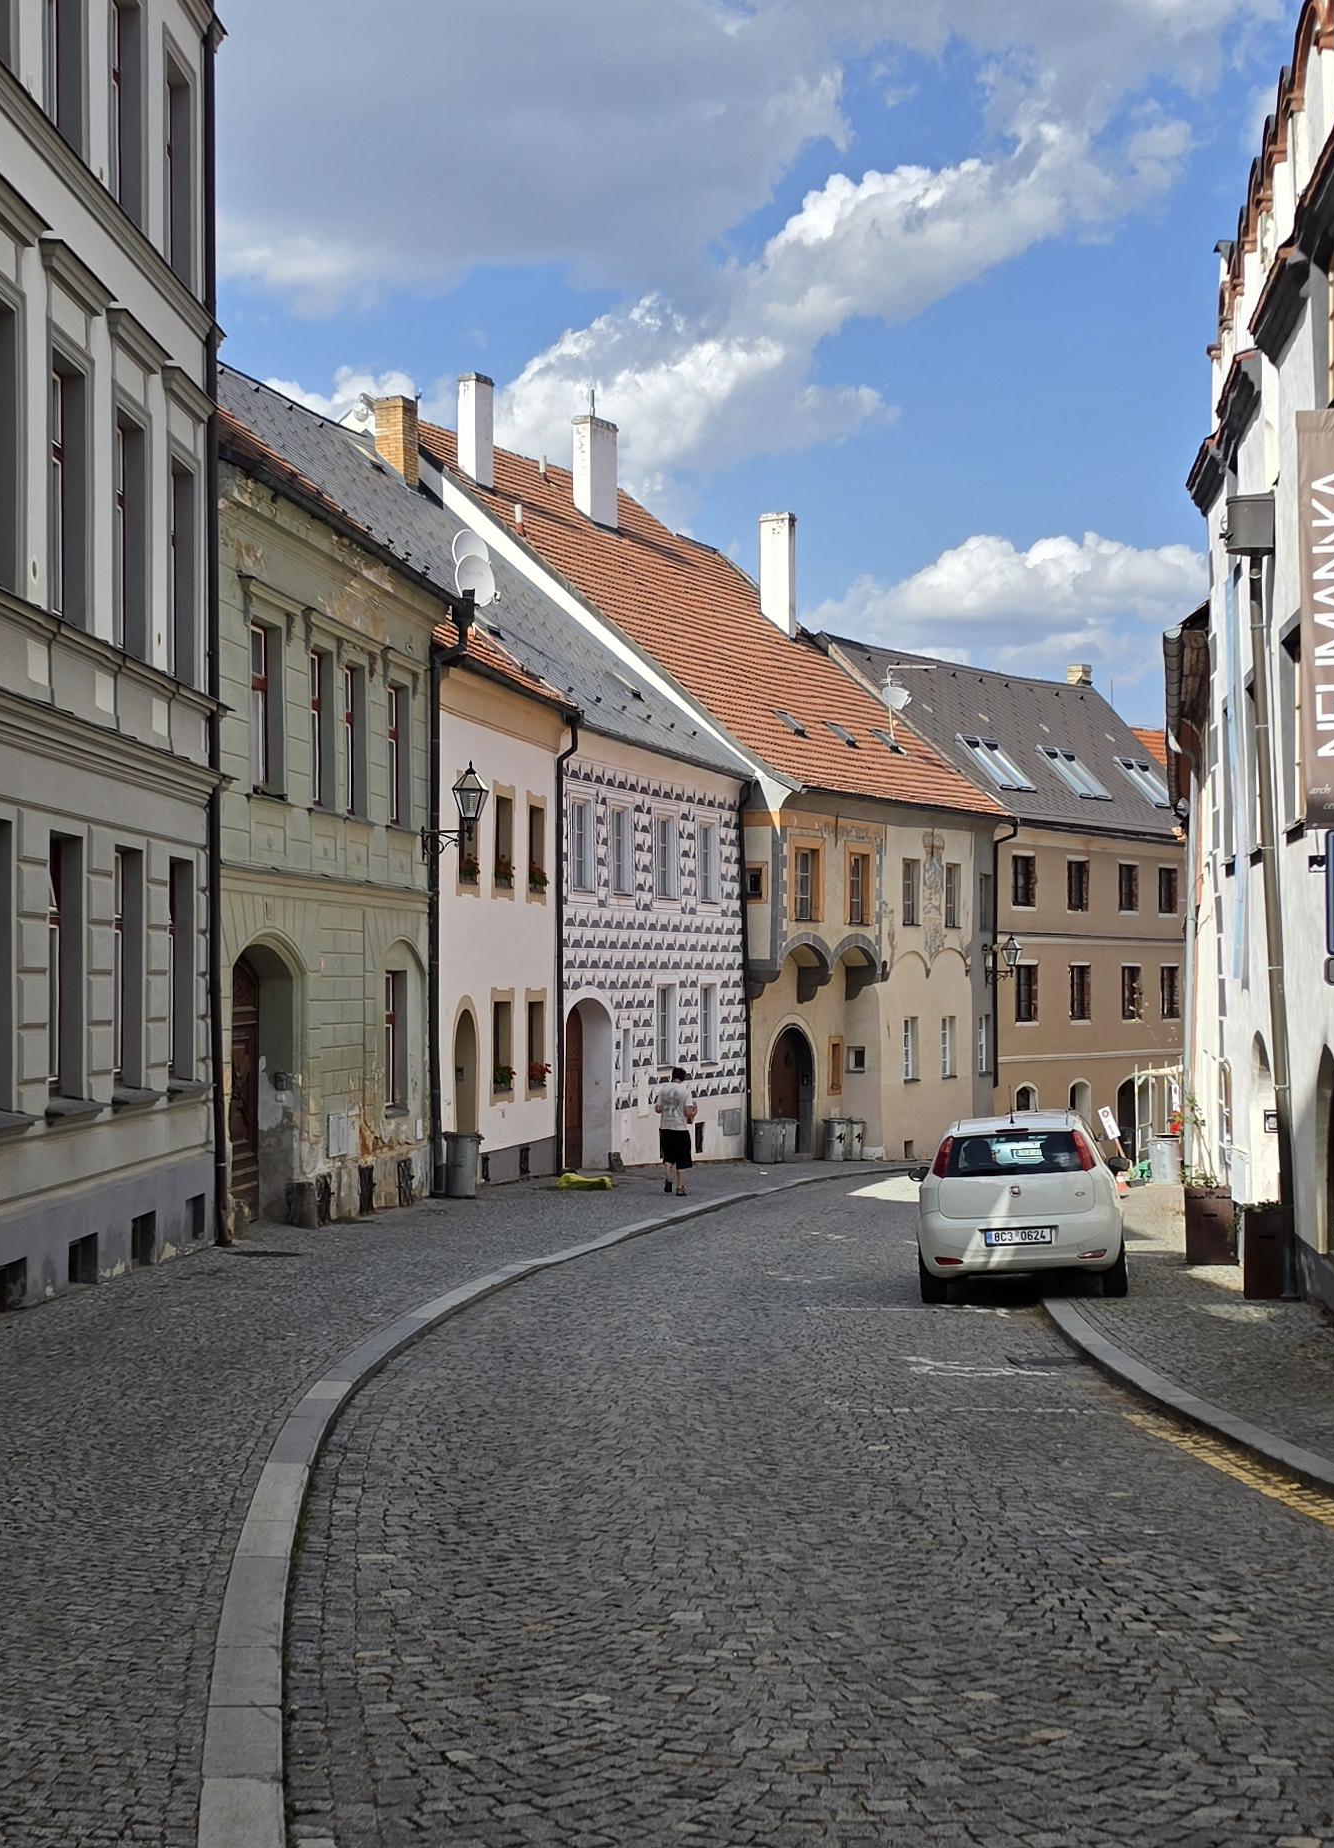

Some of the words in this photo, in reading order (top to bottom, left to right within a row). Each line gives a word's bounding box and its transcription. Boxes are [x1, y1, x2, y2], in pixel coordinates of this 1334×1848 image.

[1308, 783, 1331, 795] arch
[994, 1231, 1013, 1242] 8C3
[1020, 1229, 1046, 1241] 0624
